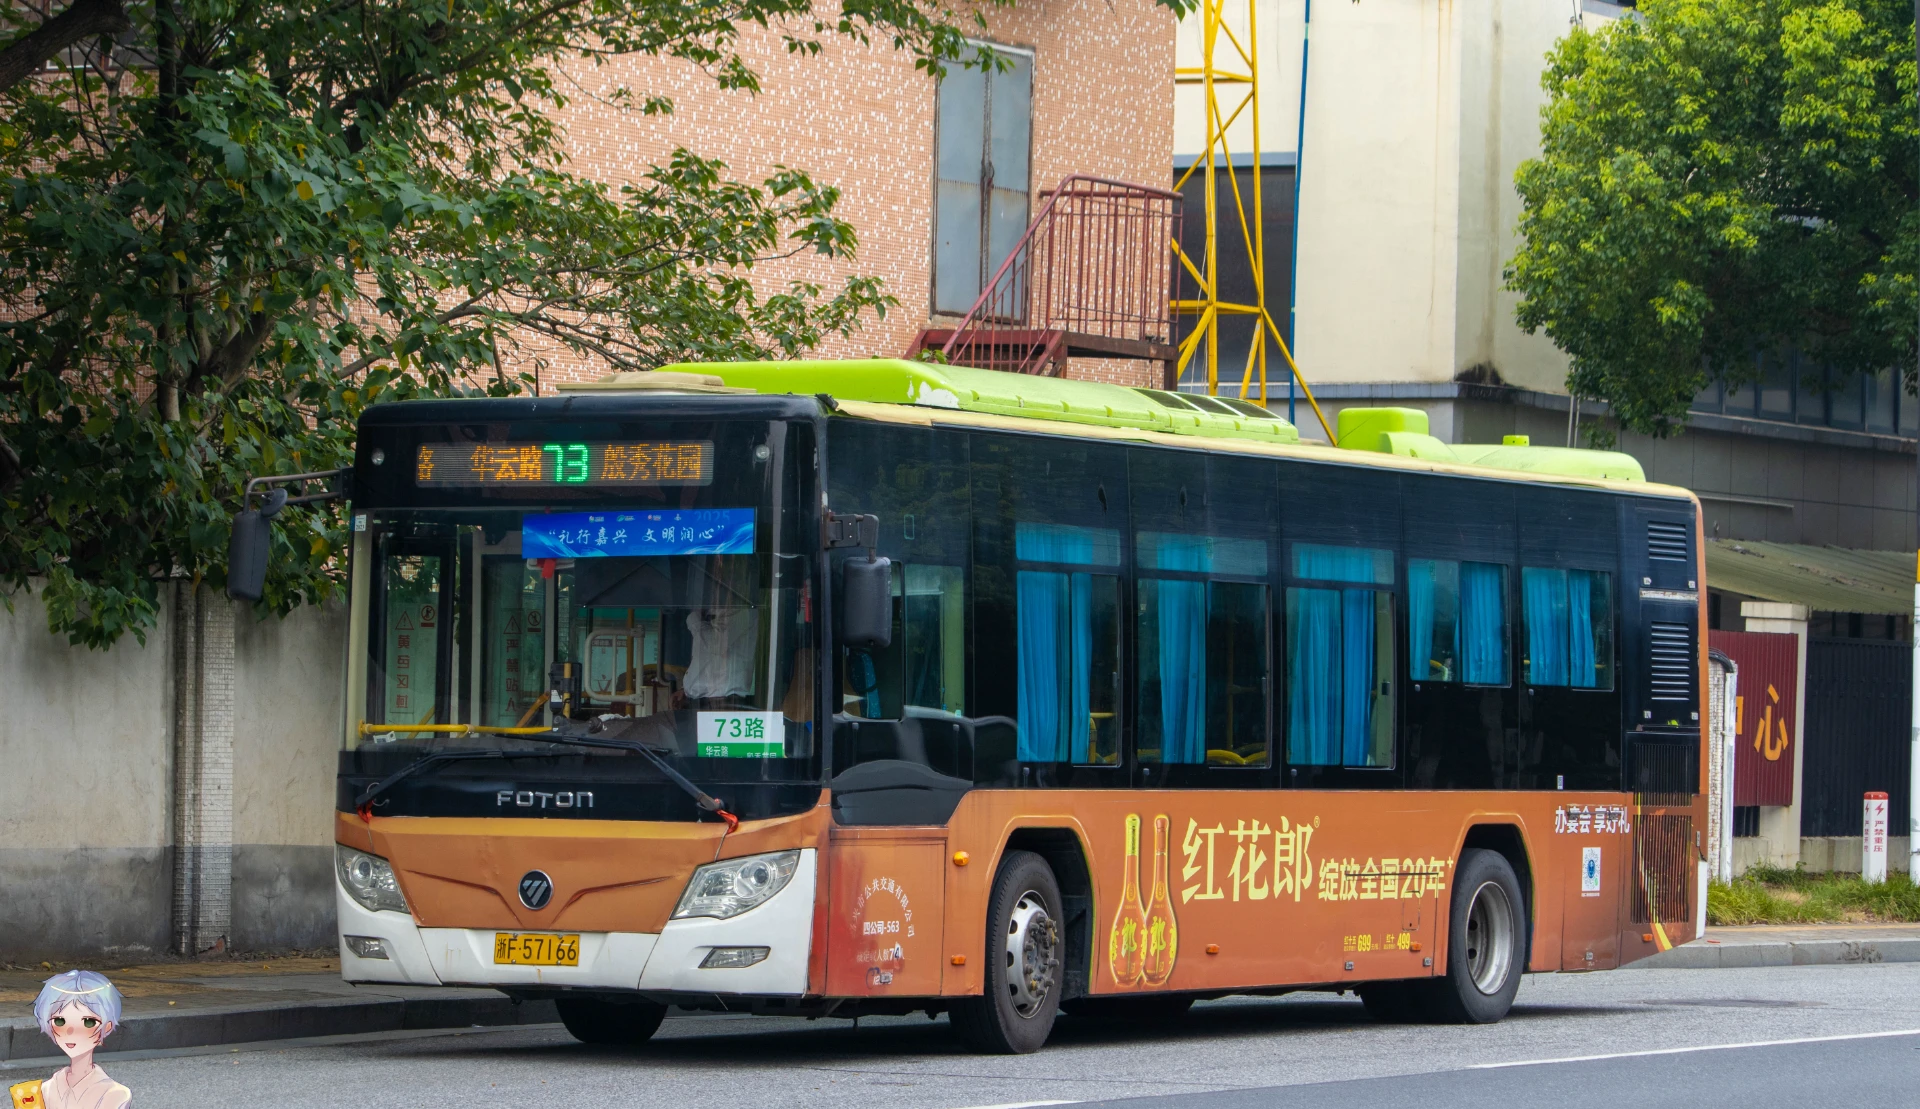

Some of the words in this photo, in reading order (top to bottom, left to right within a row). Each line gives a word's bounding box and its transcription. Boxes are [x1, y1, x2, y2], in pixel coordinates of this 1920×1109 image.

[470, 445, 542, 481] 华云路
[543, 444, 588, 482] 73
[714, 717, 765, 739] 73路
[497, 790, 594, 809] FOTON
[863, 920, 900, 935] 四公司-563
[1357, 934, 1372, 952] 699
[1396, 932, 1411, 950] 499
